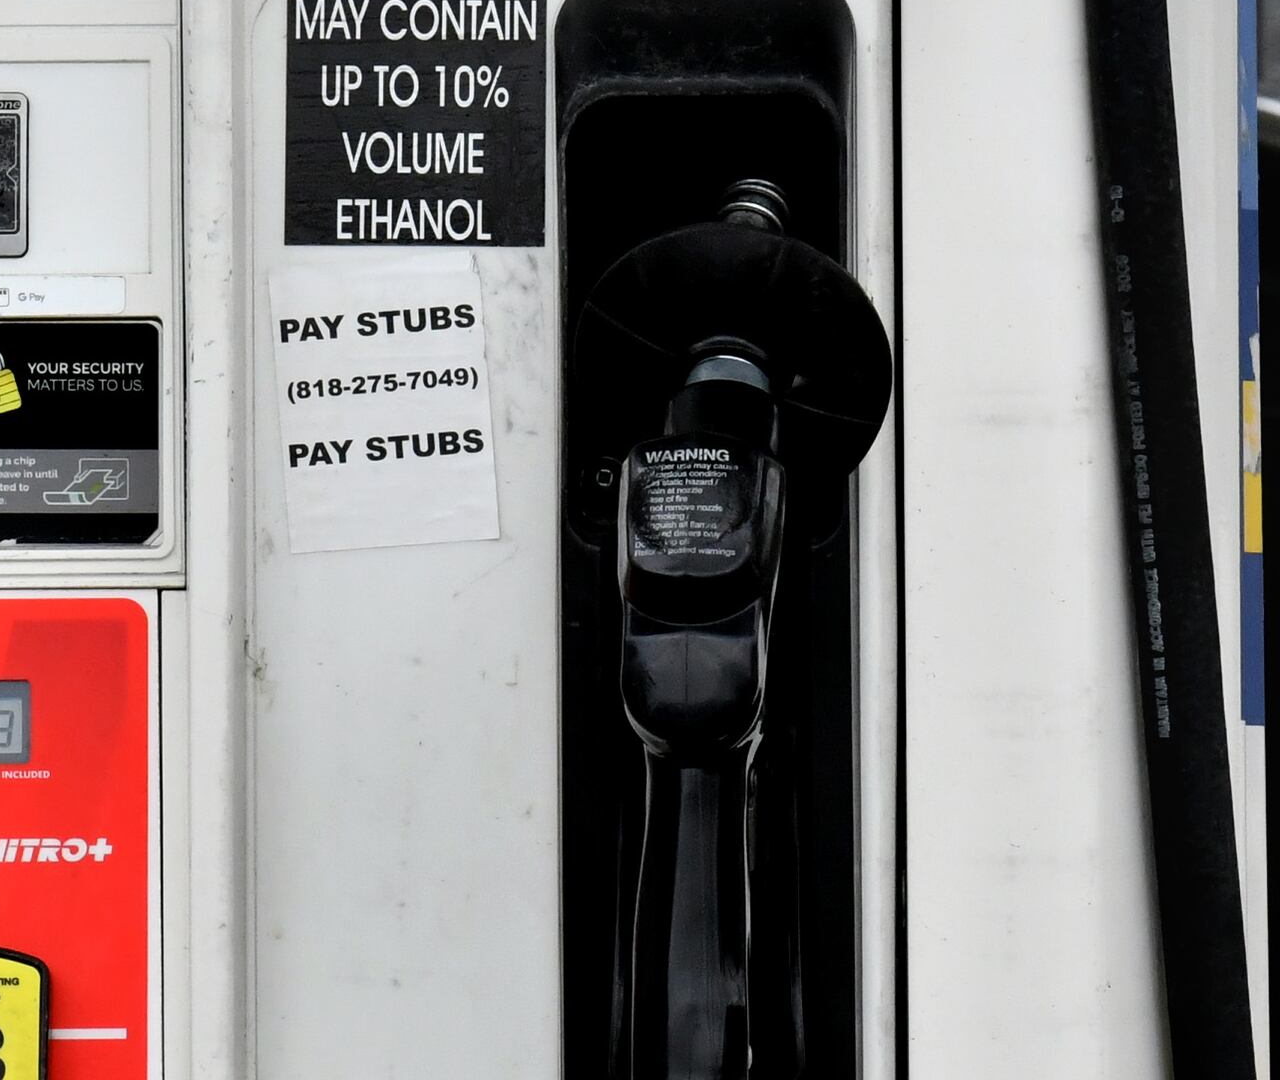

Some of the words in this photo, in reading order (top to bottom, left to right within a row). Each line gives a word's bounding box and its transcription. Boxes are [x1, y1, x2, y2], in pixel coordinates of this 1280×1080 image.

[296, 0, 369, 39] MAY
[380, 0, 536, 40] CONTAIN
[322, 65, 362, 106] UP
[374, 65, 419, 107] TO
[435, 65, 509, 107] 10%
[342, 132, 484, 174] VOLUME
[337, 199, 491, 240] ETHANOL
[280, 315, 344, 344] PAY
[357, 304, 475, 338] STUBS
[28, 363, 68, 374] YOUR
[73, 363, 143, 374] SECURITY
[28, 379, 94, 391] MATTERS
[98, 379, 118, 391] TO
[123, 380, 144, 391] US.
[287, 367, 479, 404] (818-275-7049)
[288, 440, 352, 468] PAY
[365, 429, 484, 463] STUBS
[645, 448, 730, 464] WARNING
